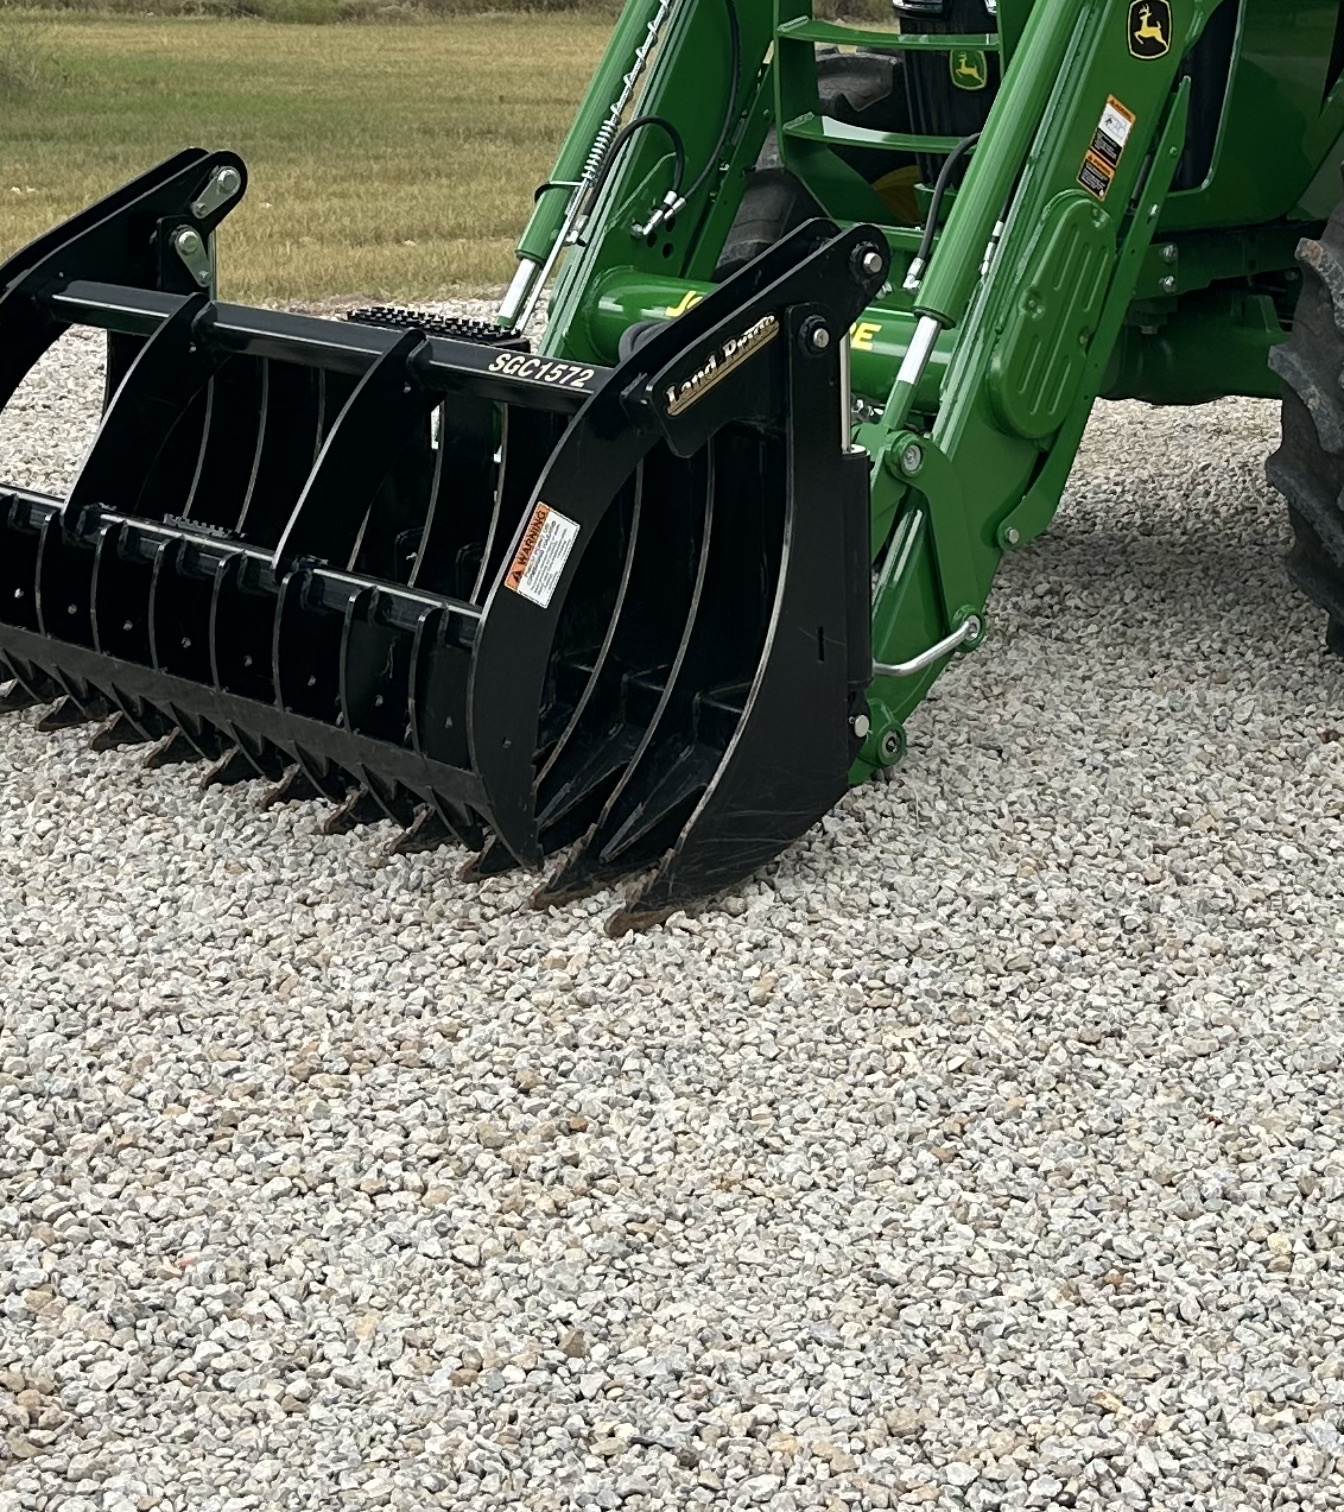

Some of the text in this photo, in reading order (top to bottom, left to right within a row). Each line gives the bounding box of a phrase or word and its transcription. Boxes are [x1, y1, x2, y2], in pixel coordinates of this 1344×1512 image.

[488, 352, 596, 389] SGC1572
[665, 354, 718, 407] Land
[517, 509, 547, 565] WARNING
